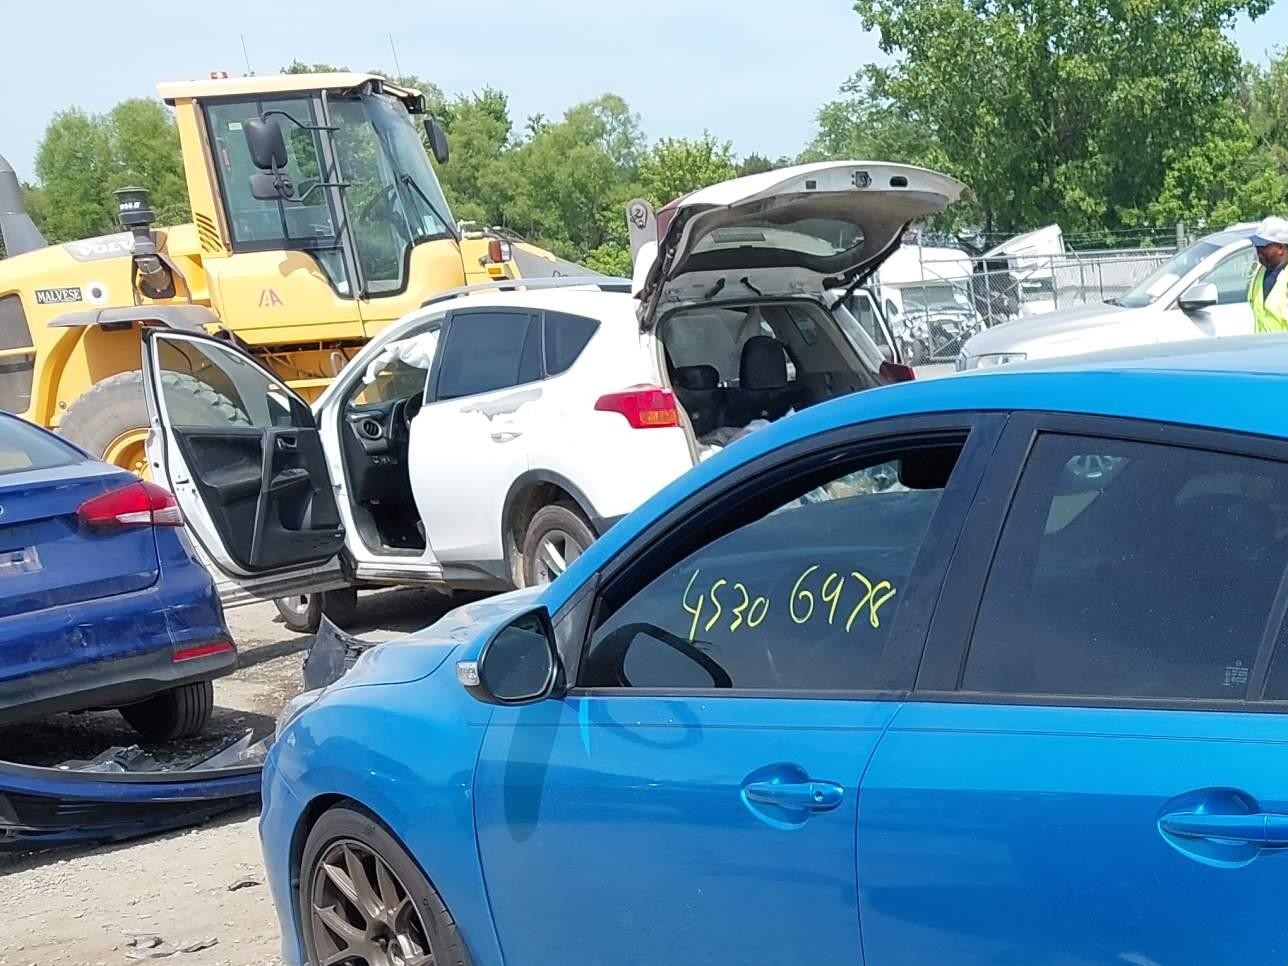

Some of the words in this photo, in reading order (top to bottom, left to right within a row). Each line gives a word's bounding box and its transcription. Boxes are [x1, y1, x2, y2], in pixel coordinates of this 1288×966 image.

[77, 238, 135, 256] VOLV
[37, 289, 81, 303] MALVESE
[683, 568, 769, 641] 4530
[790, 564, 896, 632] 6978
